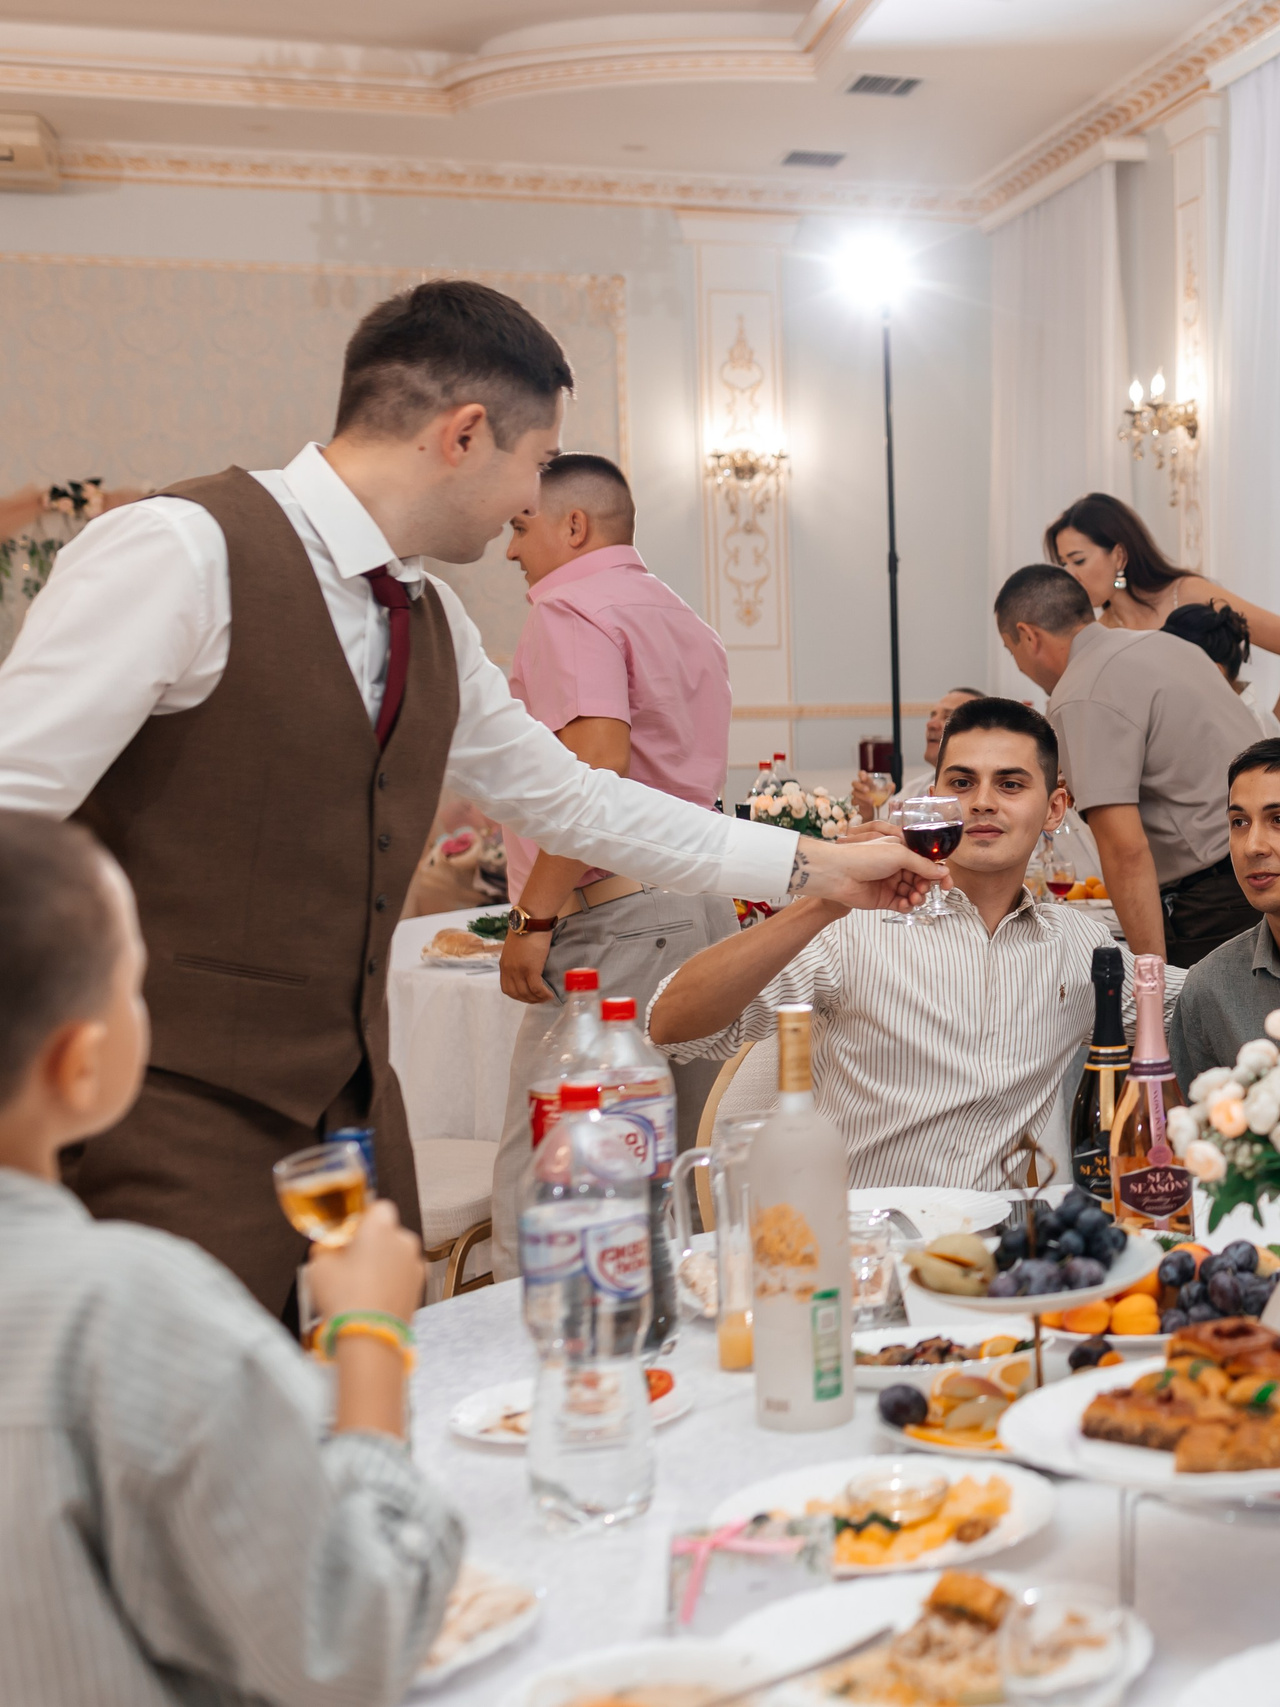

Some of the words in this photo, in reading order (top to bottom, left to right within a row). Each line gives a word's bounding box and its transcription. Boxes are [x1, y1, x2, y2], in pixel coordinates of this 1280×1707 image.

[1094, 1155, 1109, 1167] SE
[1079, 1164, 1111, 1177] SEAS
[1146, 1171, 1175, 1183] SEA
[1129, 1180, 1189, 1194] SEASONS
